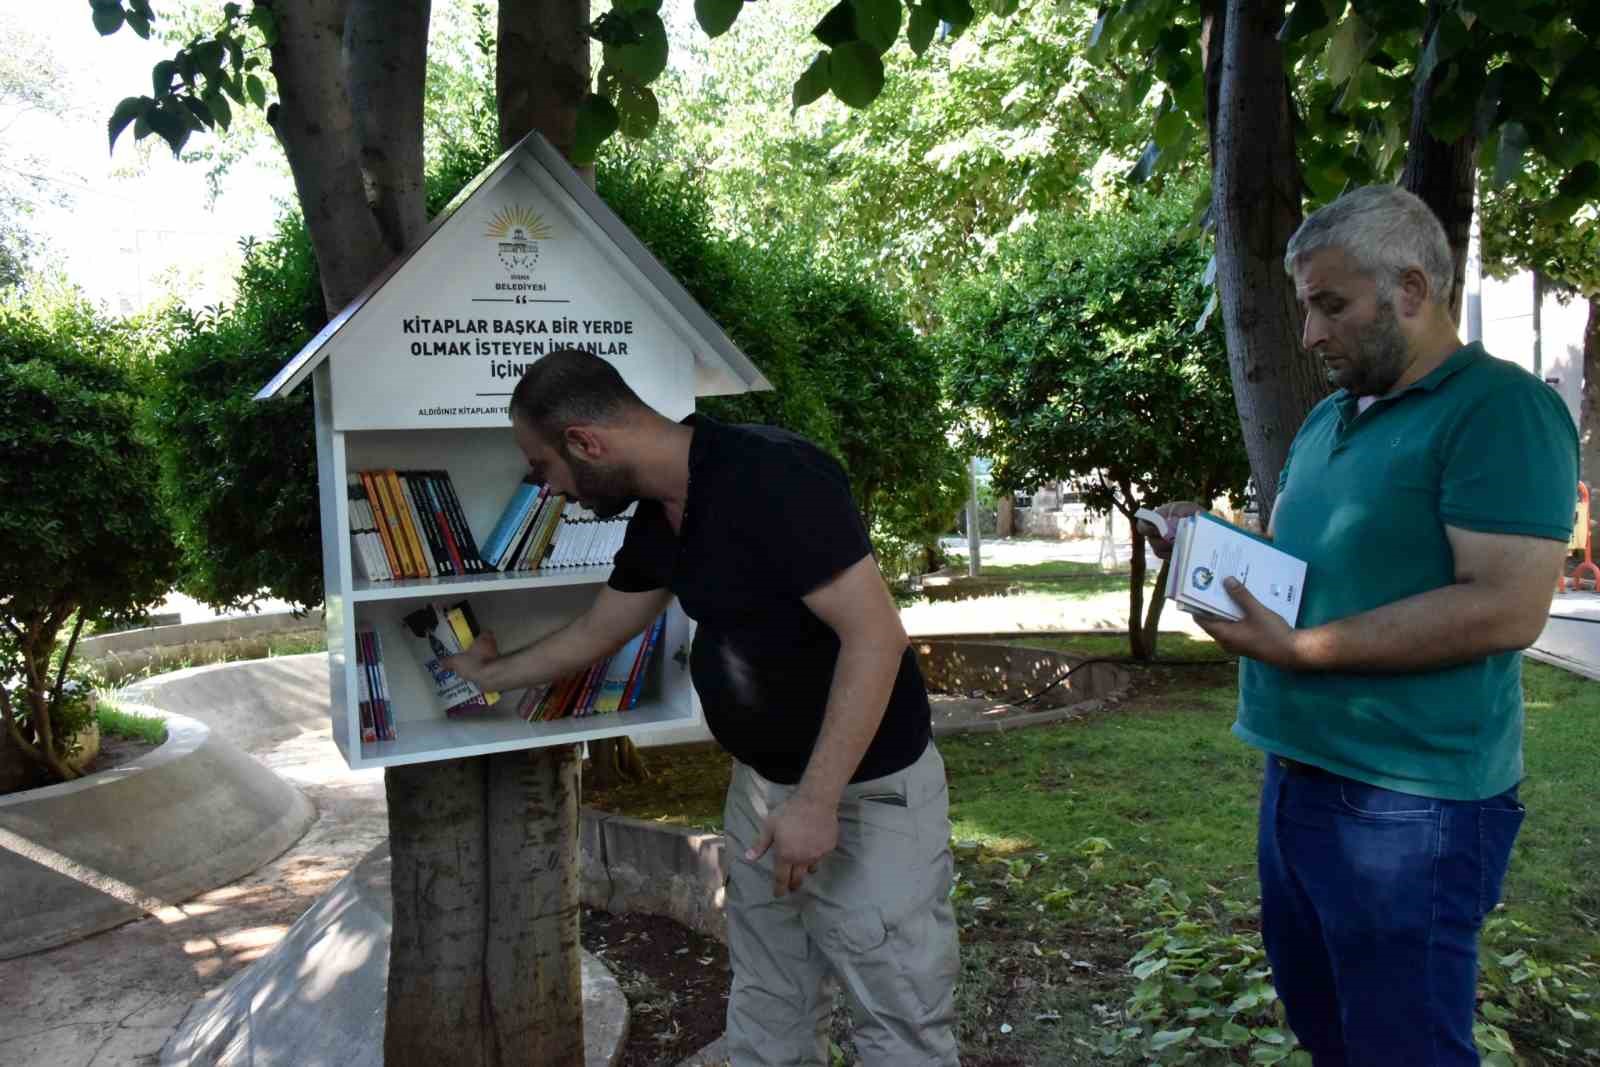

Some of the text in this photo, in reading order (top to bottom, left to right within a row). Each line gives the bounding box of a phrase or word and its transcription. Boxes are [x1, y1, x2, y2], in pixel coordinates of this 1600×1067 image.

[495, 283, 547, 291] BELEDİYESİ
[403, 315, 633, 336] KİTAPLAR BAŞKA BİR YERDE
[411, 341, 471, 356] OLMAK
[476, 337, 544, 355] İSTEYEN
[491, 359, 529, 379] İÇİN
